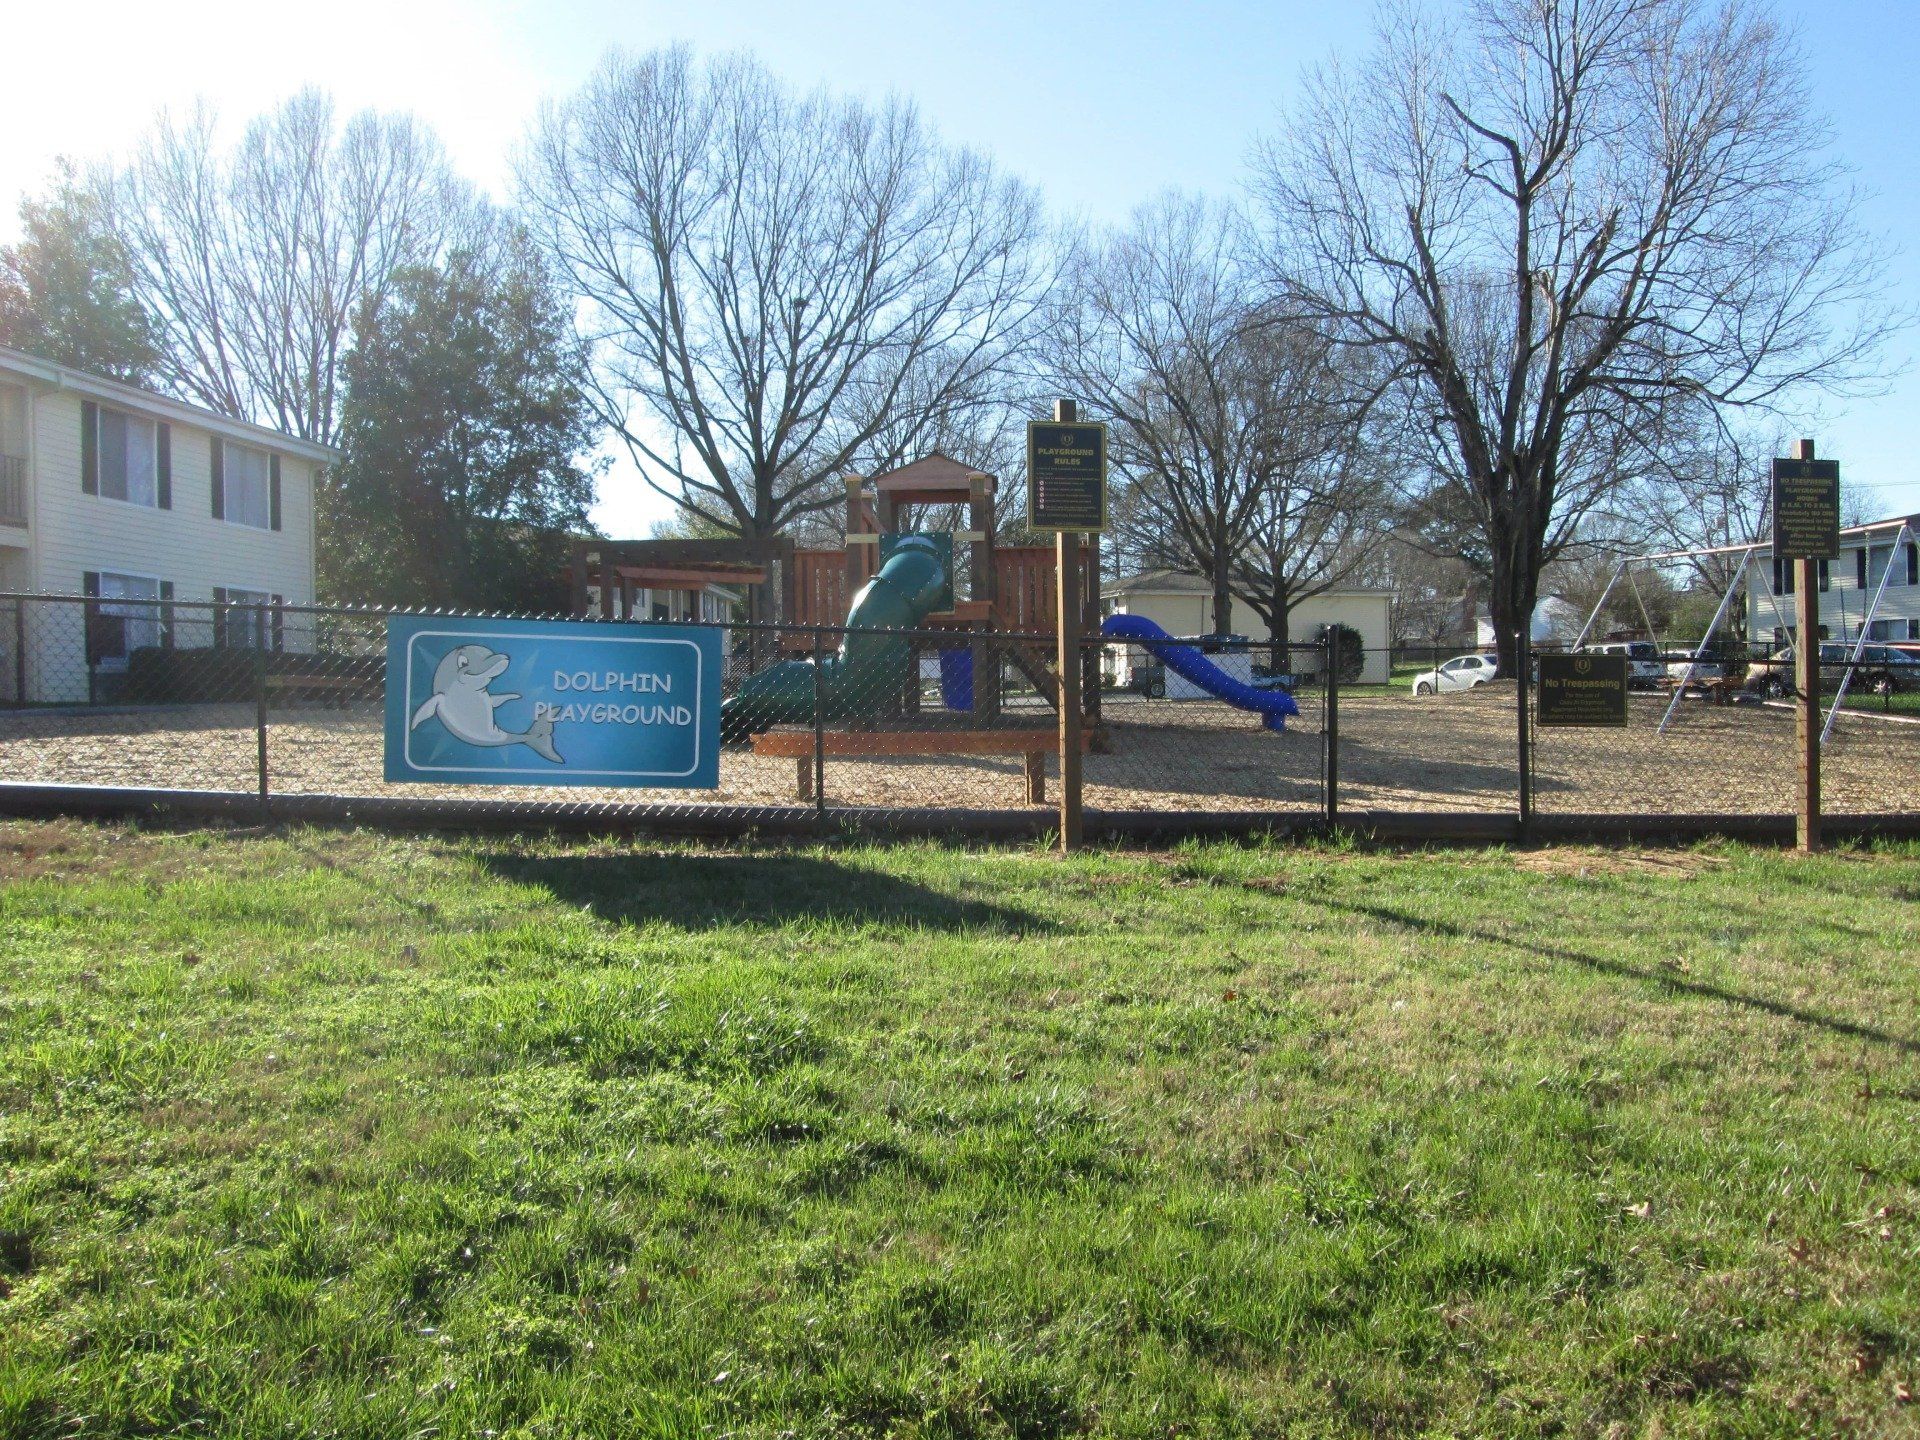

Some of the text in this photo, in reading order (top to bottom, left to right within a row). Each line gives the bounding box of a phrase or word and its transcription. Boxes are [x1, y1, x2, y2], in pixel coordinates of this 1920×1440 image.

[1037, 447, 1094, 456] PLAYGROUND
[553, 669, 673, 694] DOLPHIN
[1545, 678, 1620, 690] No Trespassing
[533, 701, 692, 727] PLAYGROUND
